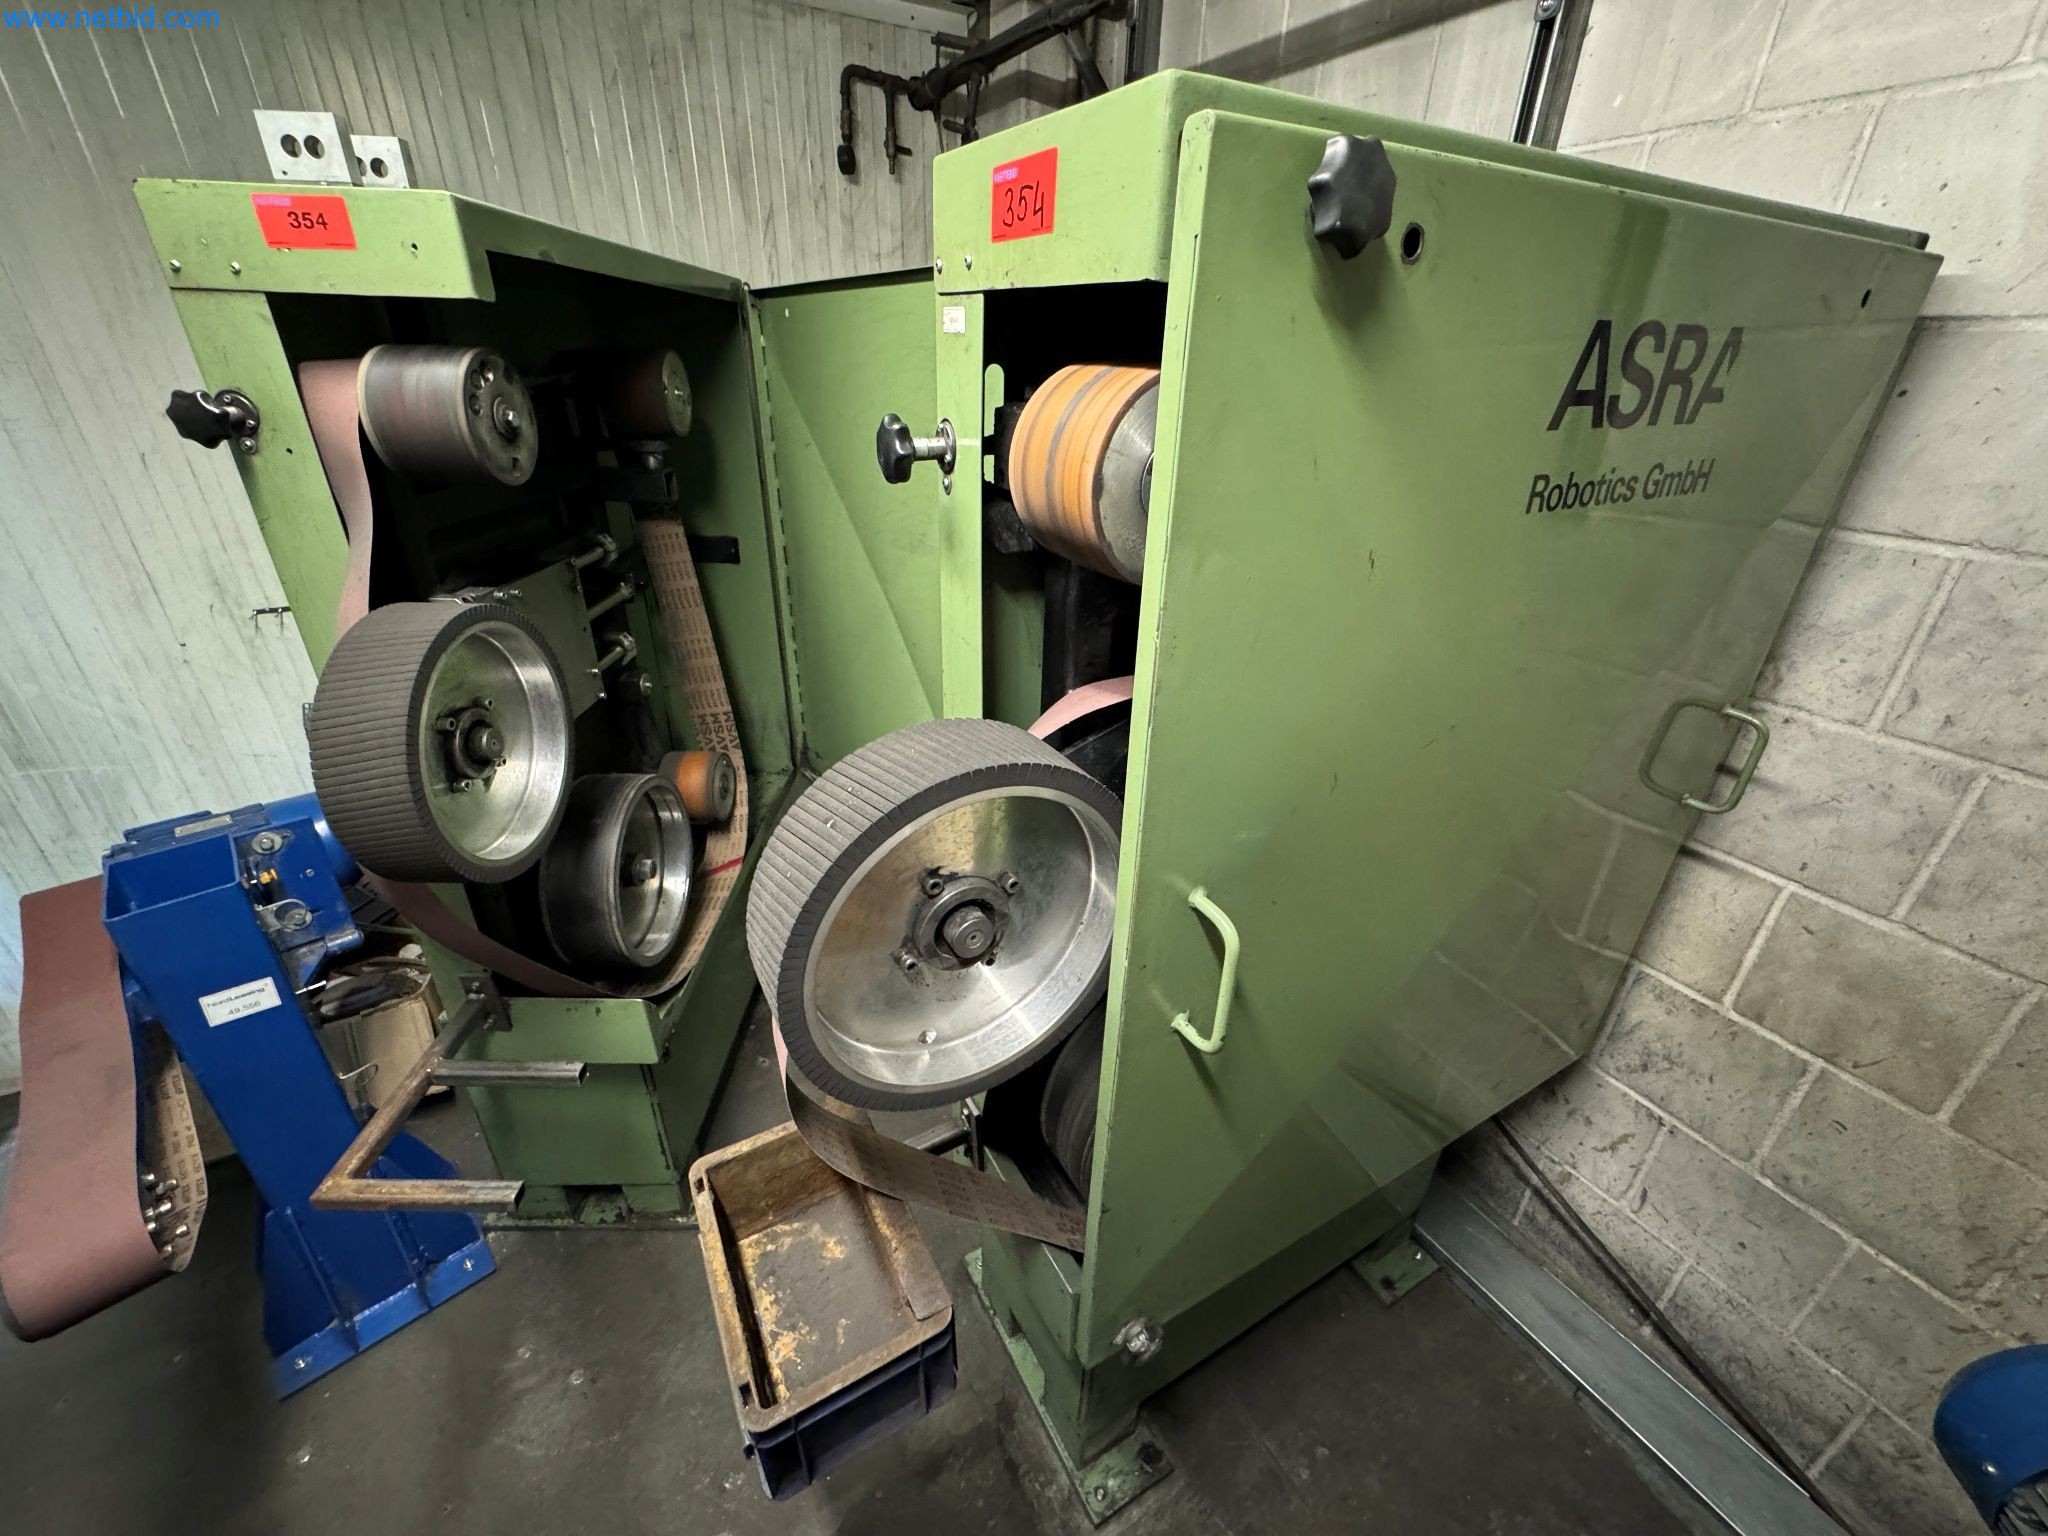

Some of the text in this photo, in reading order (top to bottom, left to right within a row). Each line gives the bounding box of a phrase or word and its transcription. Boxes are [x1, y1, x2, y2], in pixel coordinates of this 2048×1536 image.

[287, 211, 328, 230] 354
[1002, 180, 1044, 228] 354
[1546, 319, 1745, 431] ASRA
[1525, 457, 1716, 514] Robotics GmbH
